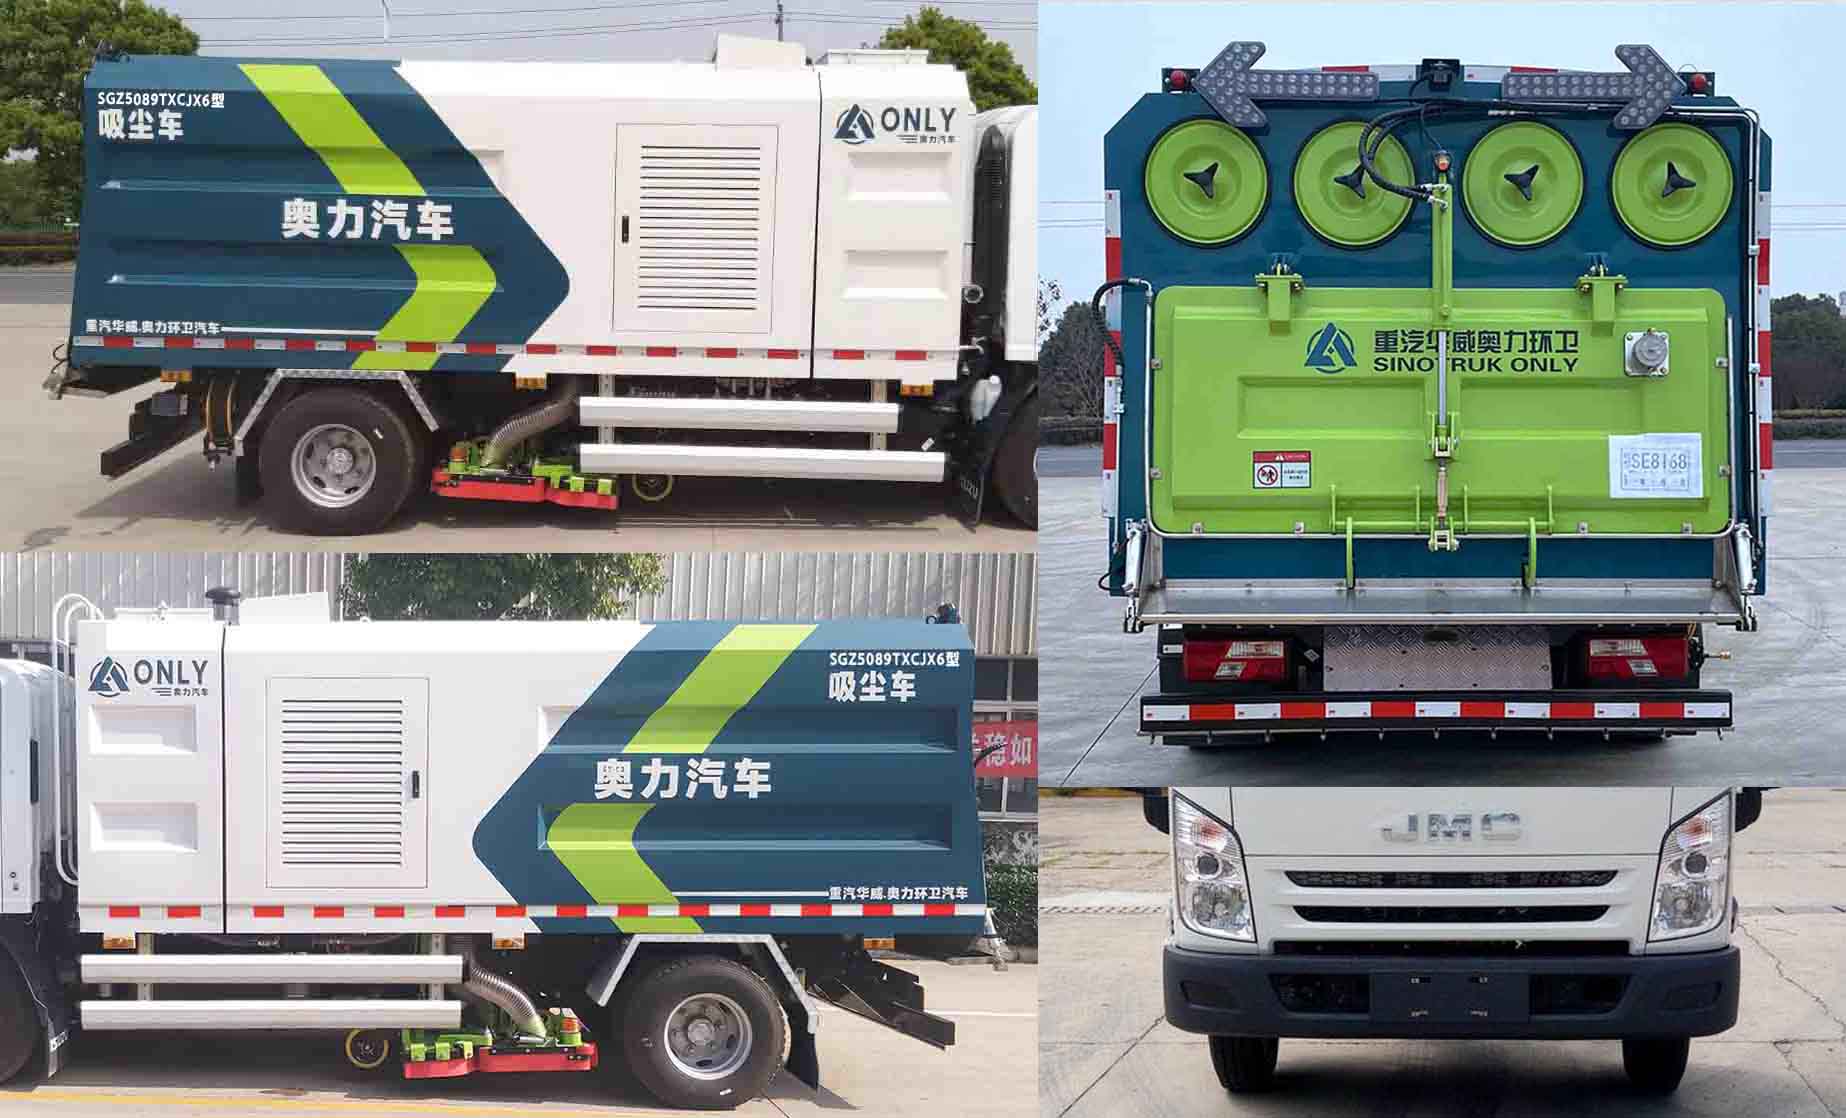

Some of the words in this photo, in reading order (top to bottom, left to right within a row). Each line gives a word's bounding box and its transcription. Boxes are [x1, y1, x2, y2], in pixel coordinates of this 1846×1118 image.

[97, 92, 225, 109] SGZ5089TXCJX6型
[98, 108, 184, 140] 吸尘车
[881, 106, 956, 132] ONLY
[281, 197, 454, 241] 奥力汽车
[1374, 329, 1579, 353] 重汽华威奥力环卫
[1510, 357, 1579, 372] ONLY
[829, 650, 960, 667] SGZ5089TXCJX6型
[133, 659, 209, 686] ONLY
[828, 669, 916, 702] 吸尘车
[594, 757, 772, 799] 奥力汽车
[1381, 812, 1521, 842] JMC
